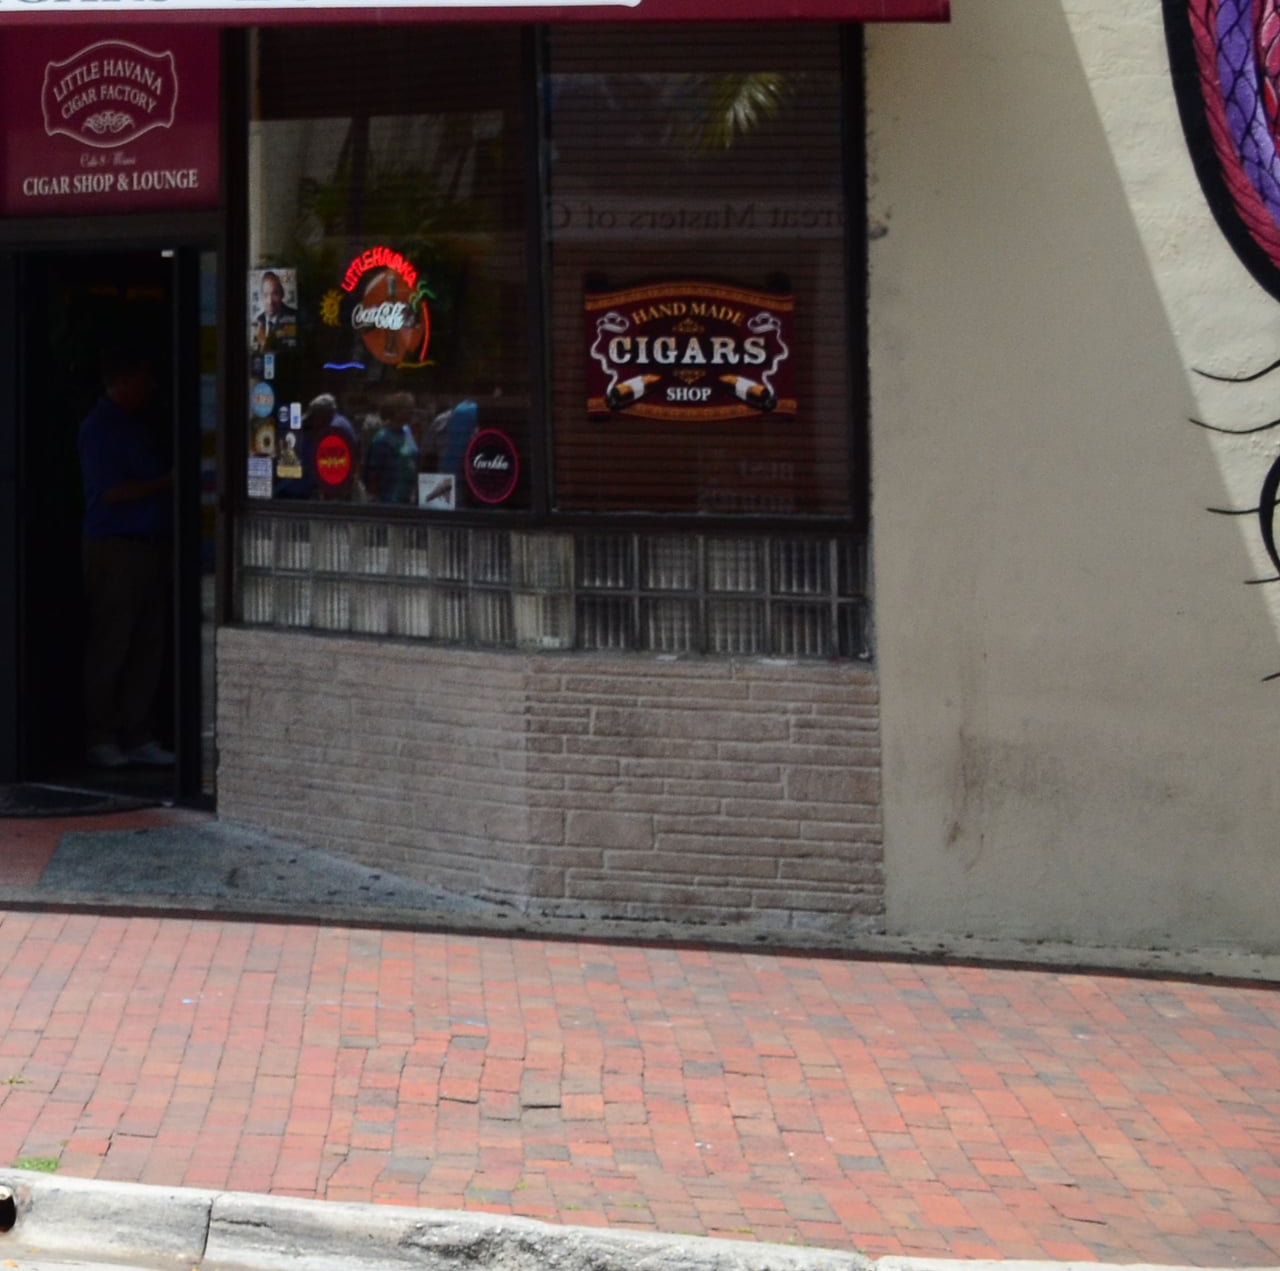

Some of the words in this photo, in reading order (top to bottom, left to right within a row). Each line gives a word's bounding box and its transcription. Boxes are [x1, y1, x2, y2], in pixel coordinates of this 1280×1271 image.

[53, 60, 100, 103] LITTLE
[103, 59, 162, 96] HAVANA
[61, 87, 98, 119] CIGAR
[100, 83, 157, 114] FACTORY
[23, 176, 71, 197] CIGAR
[73, 173, 114, 194] SHOP
[116, 173, 129, 192] &
[132, 168, 199, 191] LOUNGE
[631, 302, 688, 326] HAND
[690, 302, 745, 327] MADE
[608, 335, 768, 365] CIGARS
[666, 385, 712, 402] SHOP
